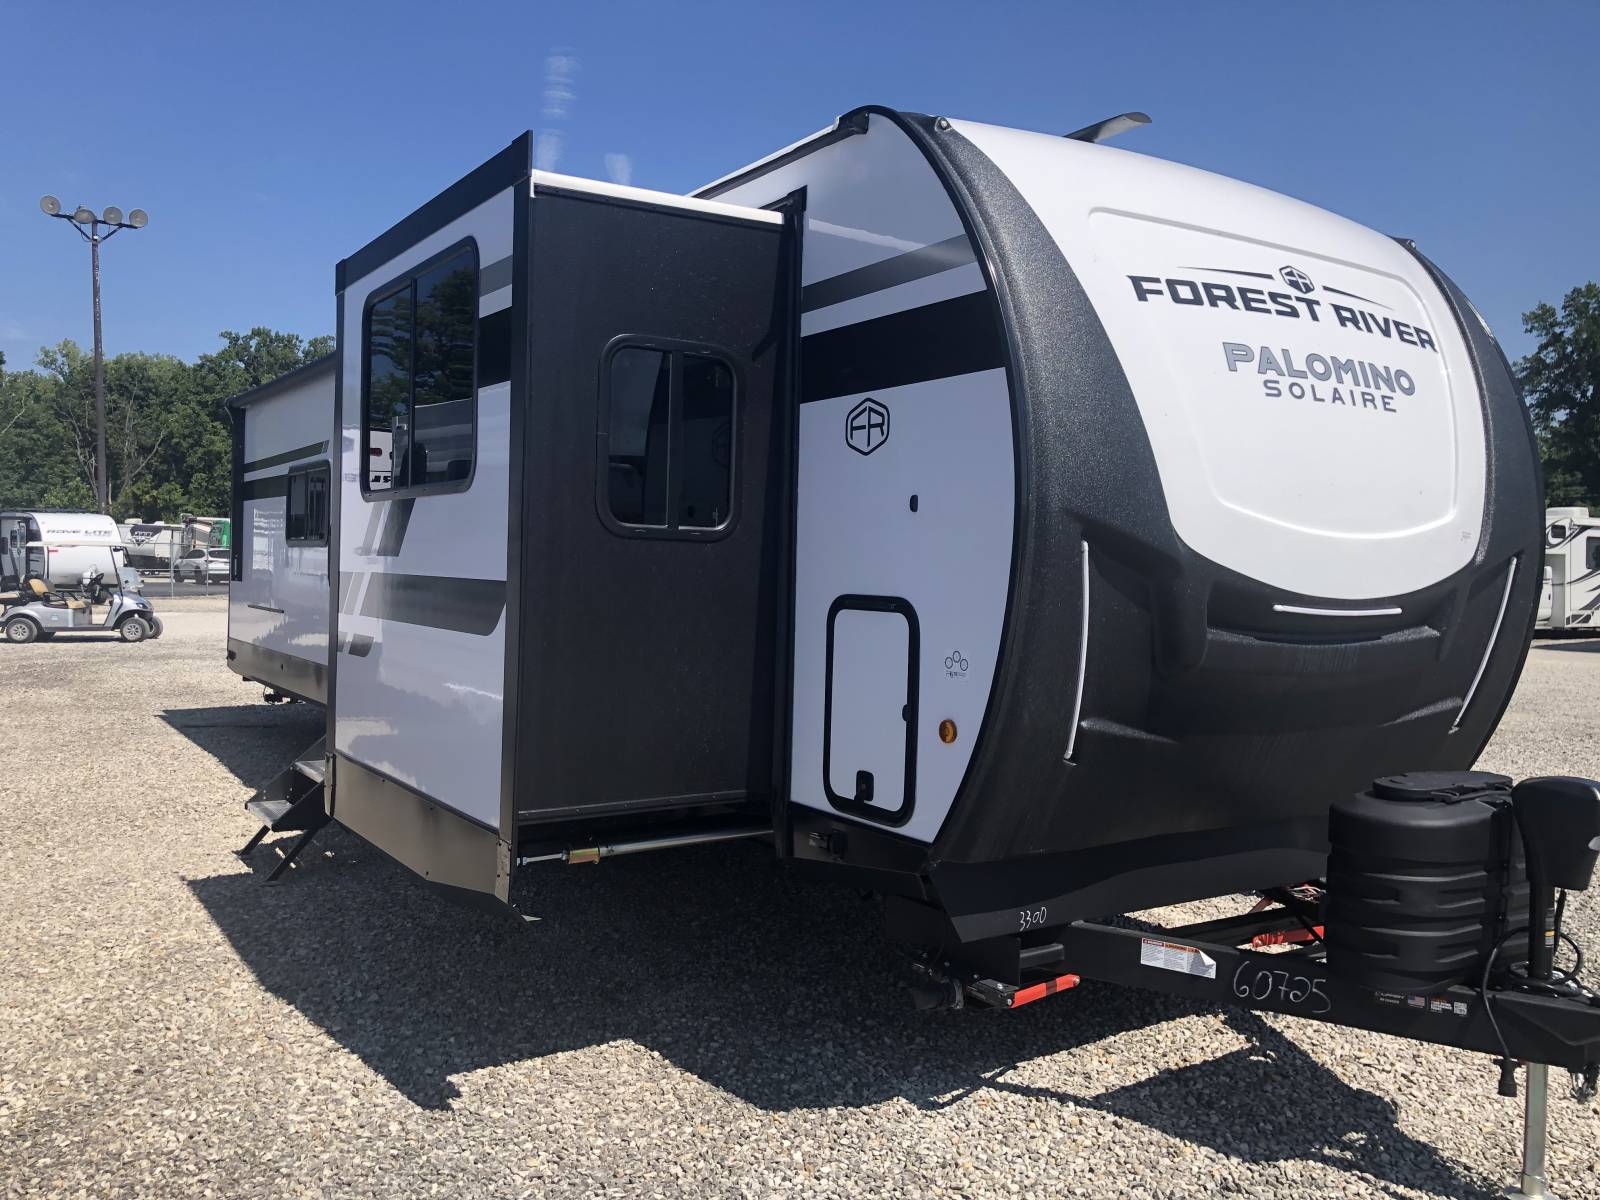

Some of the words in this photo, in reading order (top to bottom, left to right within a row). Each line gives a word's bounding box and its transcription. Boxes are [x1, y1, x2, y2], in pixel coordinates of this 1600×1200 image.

[1126, 274, 1321, 322] FOREST
[1329, 302, 1439, 353] RIVER
[1222, 341, 1416, 397] PALOMINO
[1263, 379, 1398, 413] SOLAIRE
[1018, 906, 1047, 932] 3300
[1232, 960, 1332, 1014] 60725
